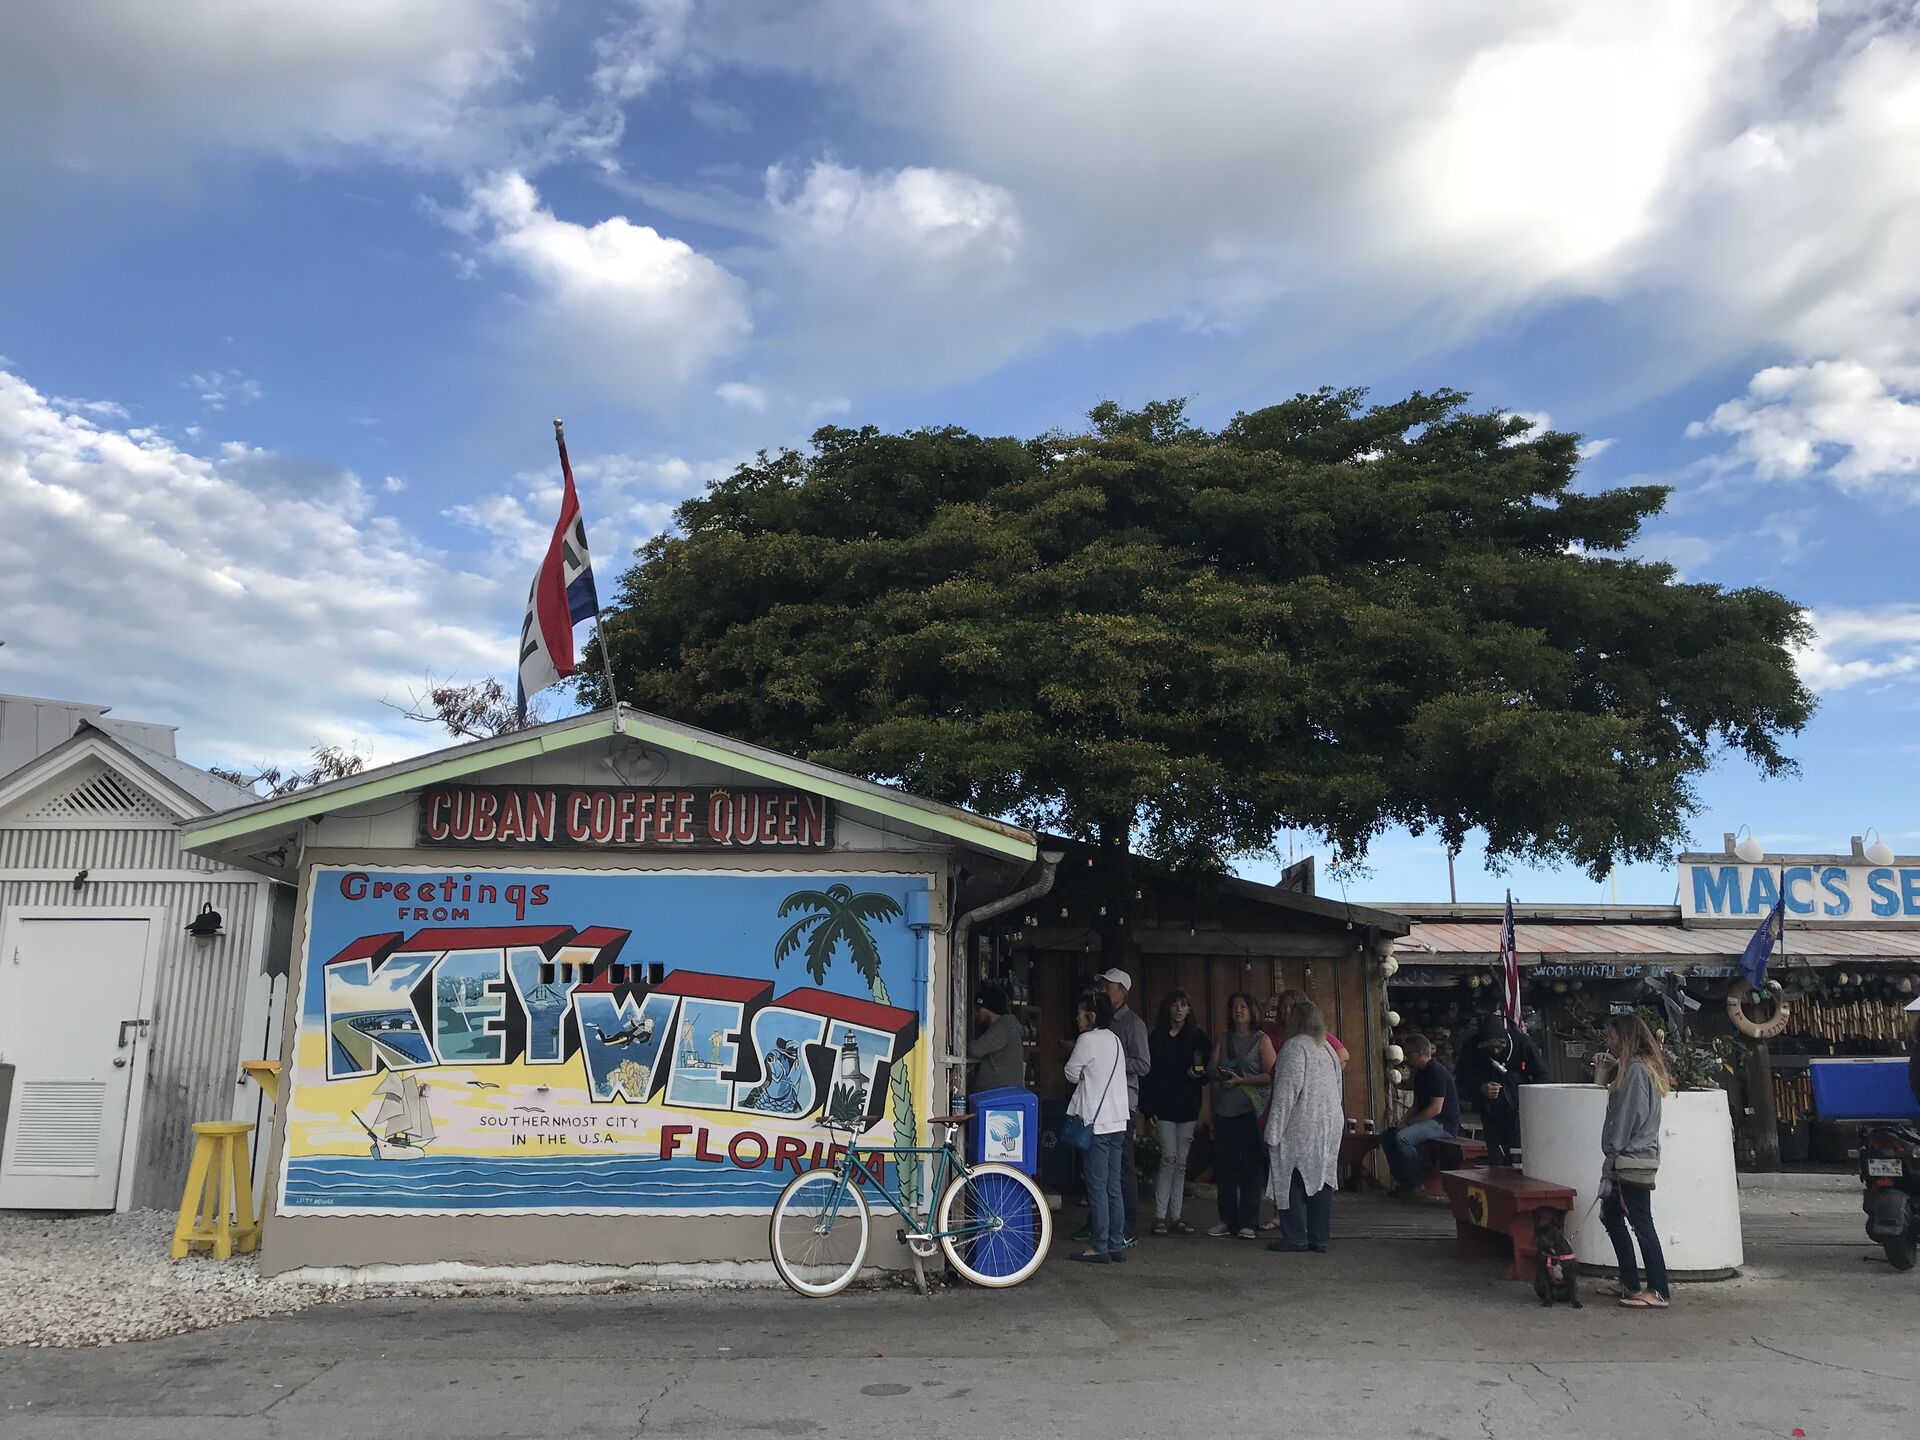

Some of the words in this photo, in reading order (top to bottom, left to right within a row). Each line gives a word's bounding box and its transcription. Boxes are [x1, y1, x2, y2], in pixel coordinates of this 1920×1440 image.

[427, 791, 555, 841] CUBAN
[566, 791, 695, 843] COFFEE
[708, 791, 826, 846] QUEEN
[398, 907, 470, 921] FROM
[1692, 864, 1850, 916] MAC'S
[1624, 965, 1643, 977] OF
[323, 930, 603, 1081] KEY
[572, 980, 910, 1132] WEST
[480, 1116, 598, 1127] SOUTHERNMOST
[606, 1117, 639, 1129] CITY
[512, 1134, 526, 1145] IN
[537, 1134, 567, 1145] THE
[578, 1133, 618, 1144] U.S.A.
[660, 1125, 885, 1186] FLORIDA
